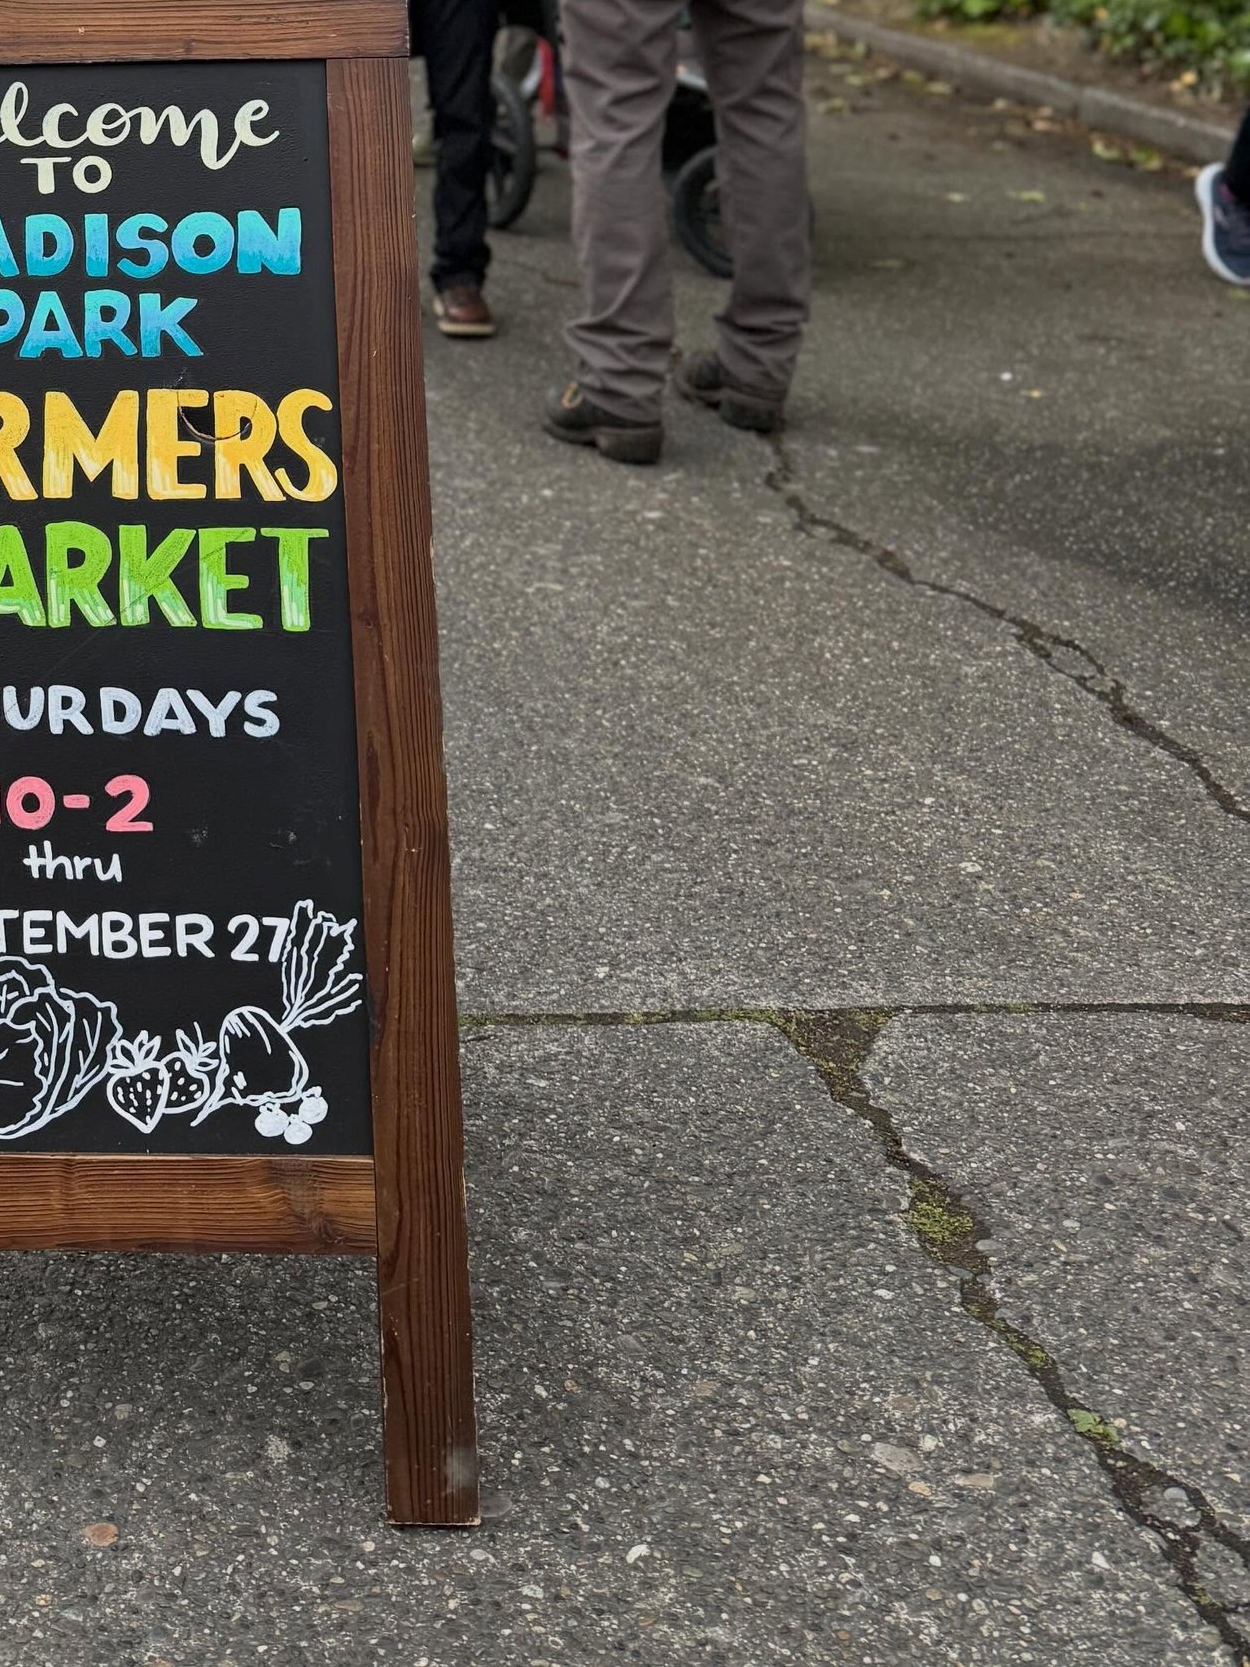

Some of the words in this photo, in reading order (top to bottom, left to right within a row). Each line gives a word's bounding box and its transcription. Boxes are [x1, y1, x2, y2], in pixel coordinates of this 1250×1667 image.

[19, 155, 113, 195] TO
[21, 839, 123, 883] thru
[227, 913, 291, 963] 27
